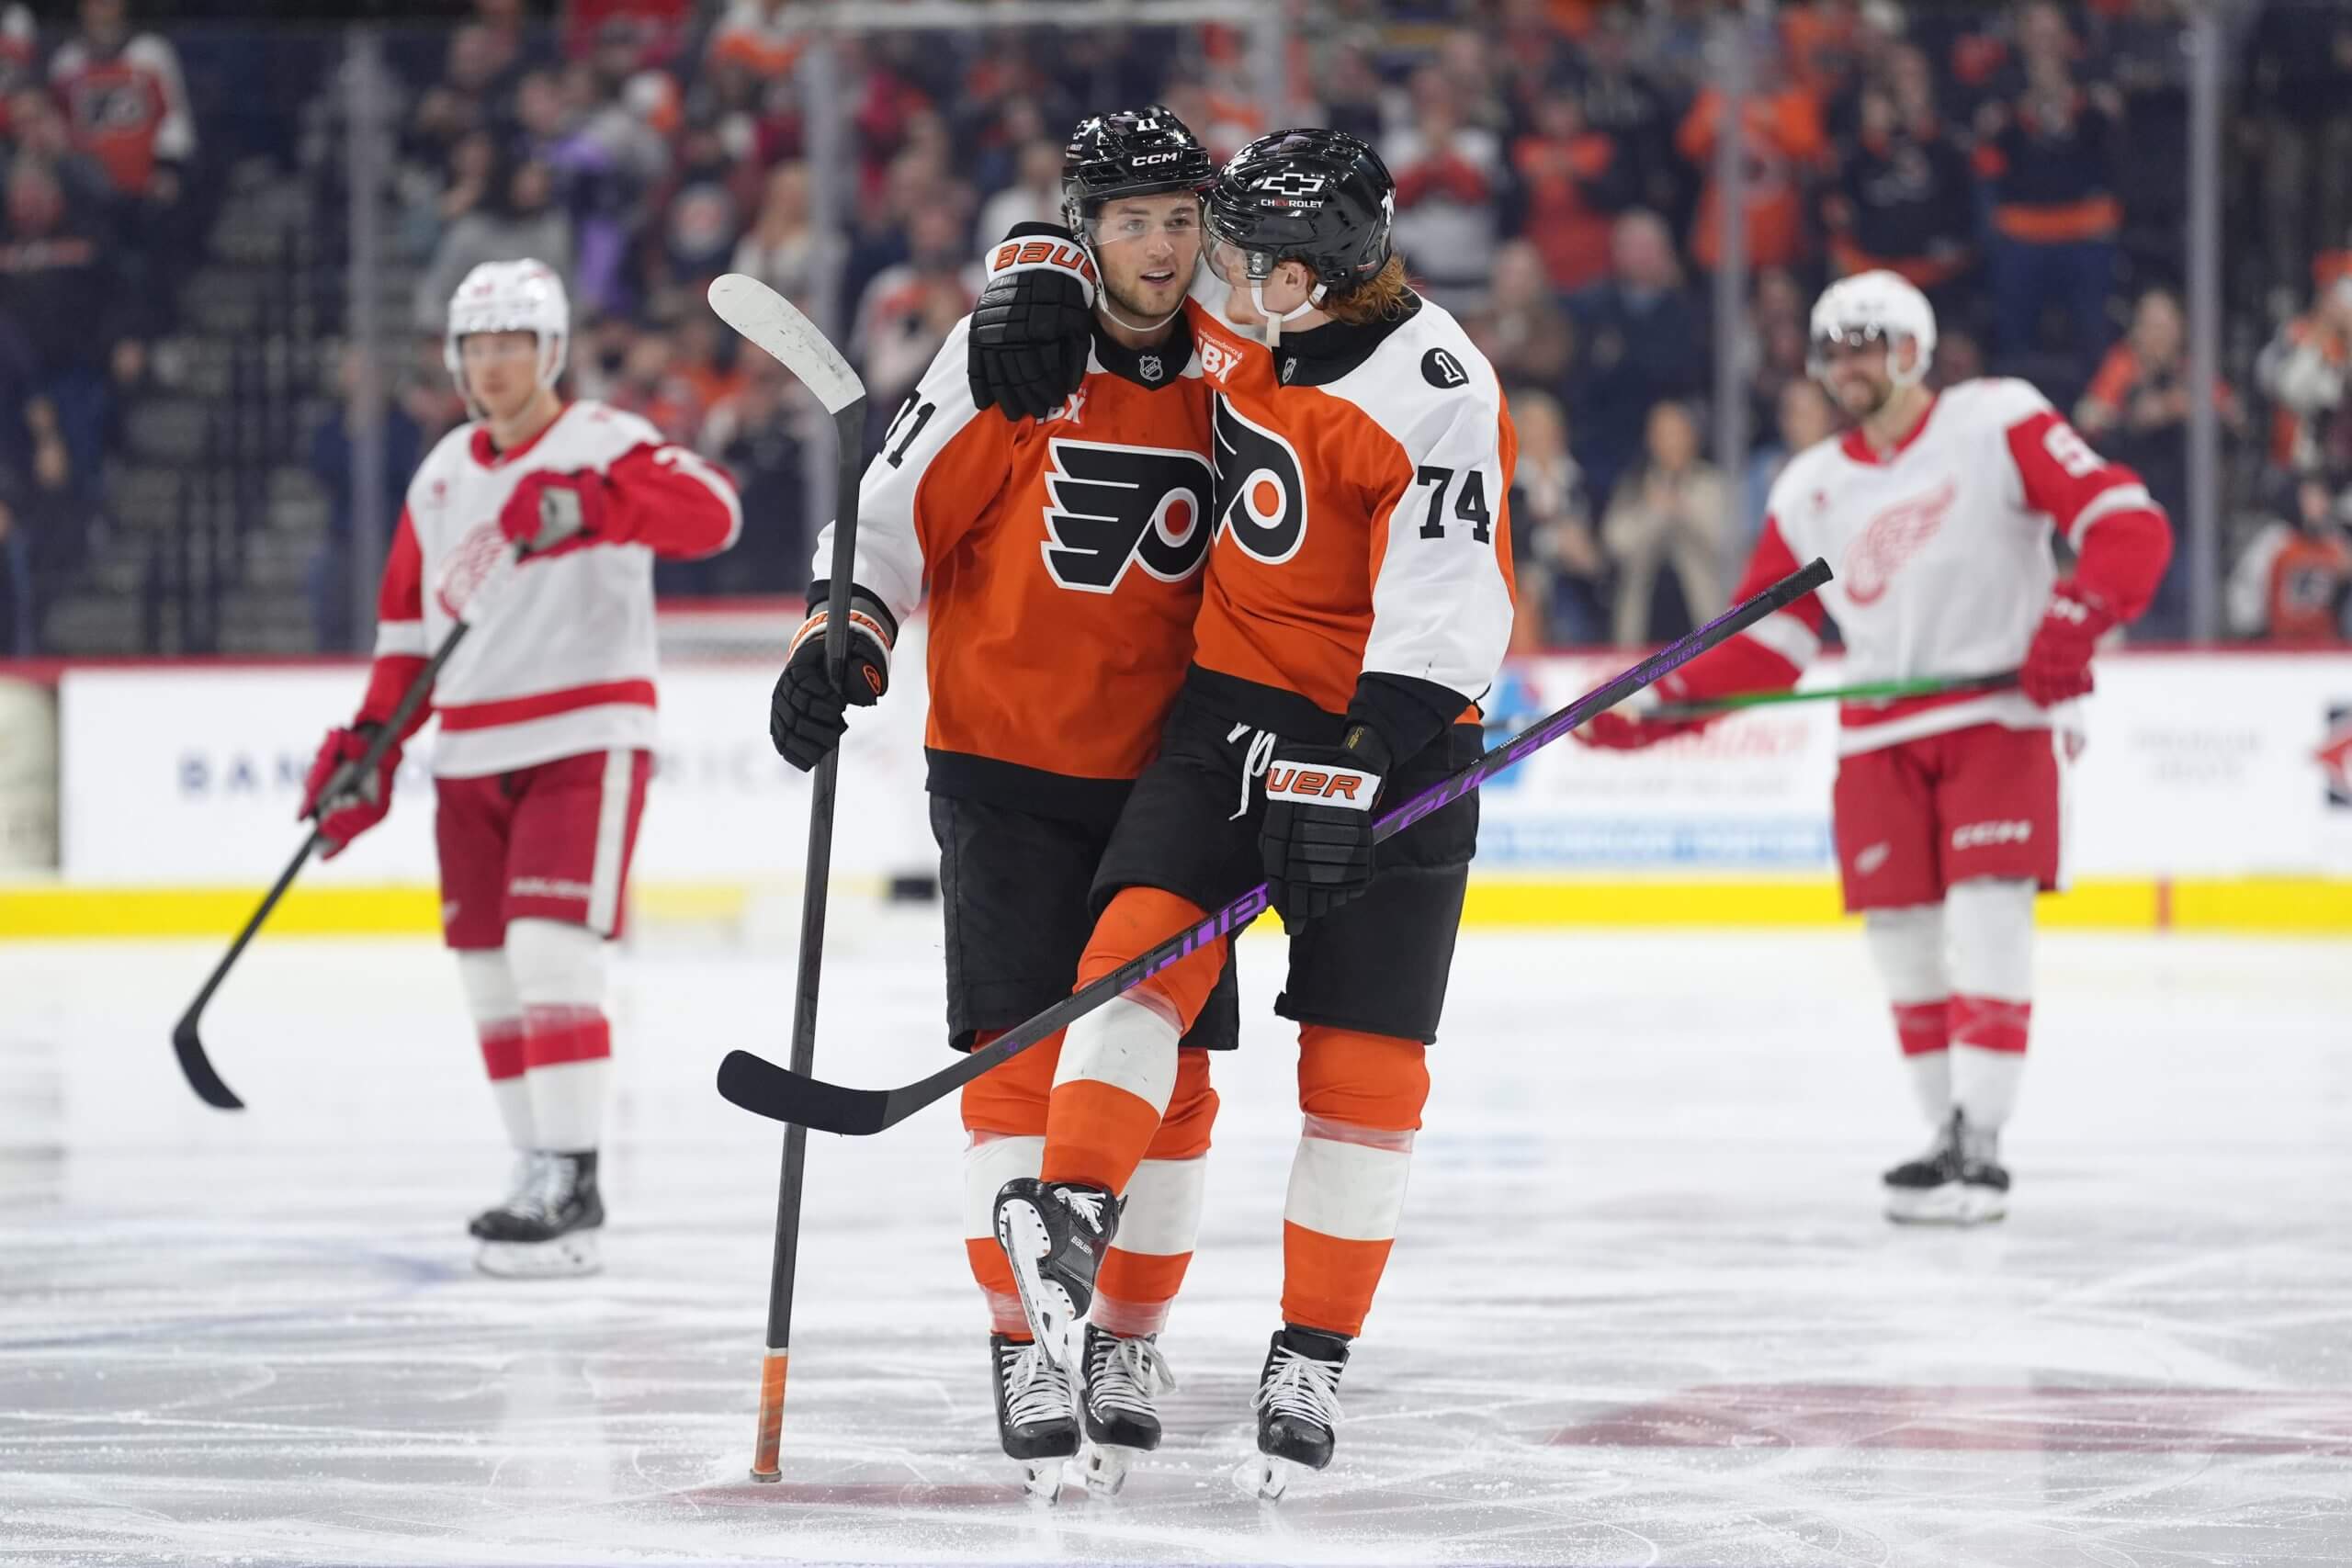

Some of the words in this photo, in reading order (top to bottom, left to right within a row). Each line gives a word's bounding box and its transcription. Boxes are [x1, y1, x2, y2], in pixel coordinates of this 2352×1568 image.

[1132, 152, 1178, 166] CCM
[1261, 198, 1324, 209] CHEVROLET
[1433, 351, 1464, 384] 1
[1417, 465, 1490, 545] 74
